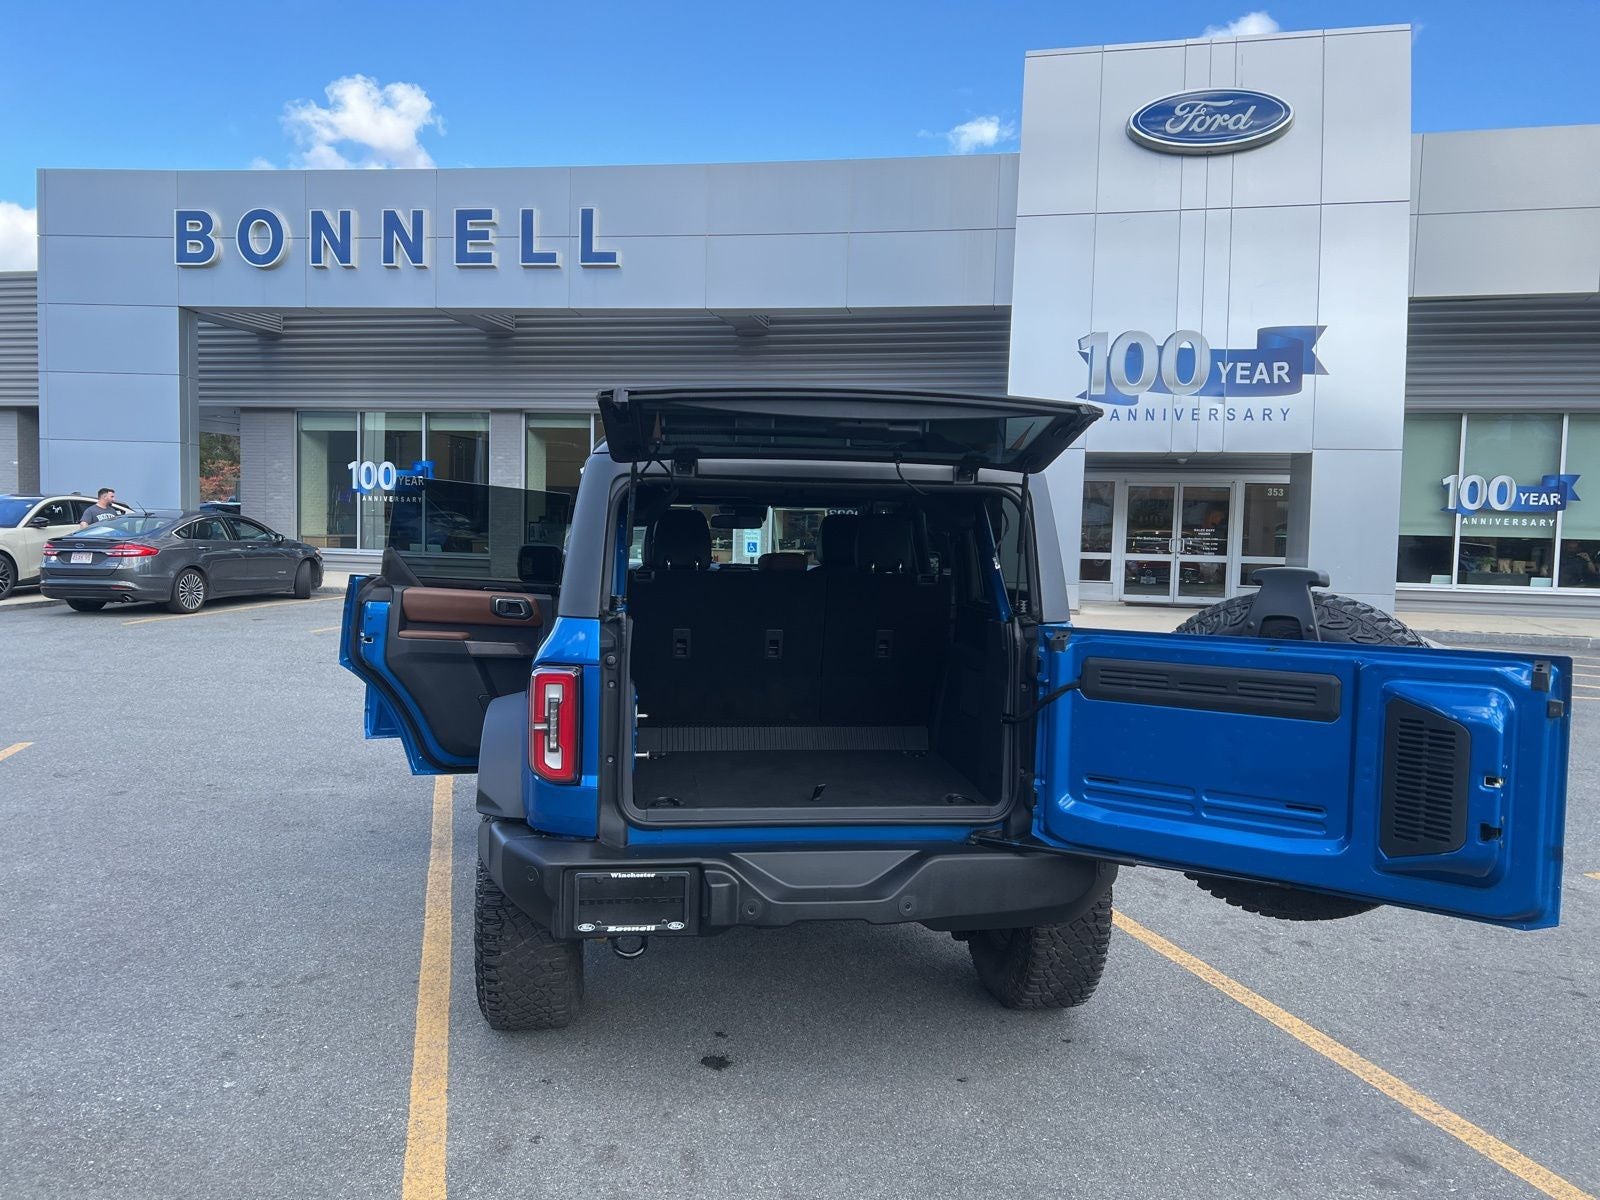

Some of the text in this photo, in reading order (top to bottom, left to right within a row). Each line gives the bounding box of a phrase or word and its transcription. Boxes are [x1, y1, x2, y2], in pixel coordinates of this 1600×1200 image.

[1165, 100, 1257, 134] Ford
[173, 207, 621, 269] BONNELL
[1078, 330, 1291, 396] 100 YEAR
[1109, 406, 1292, 422] ANNIVERSARY
[347, 461, 425, 490] 100 YEAR
[1267, 487, 1284, 497] 353
[1442, 474, 1561, 511] 100 YEAR
[1462, 516, 1556, 527] ANNIVERSARY
